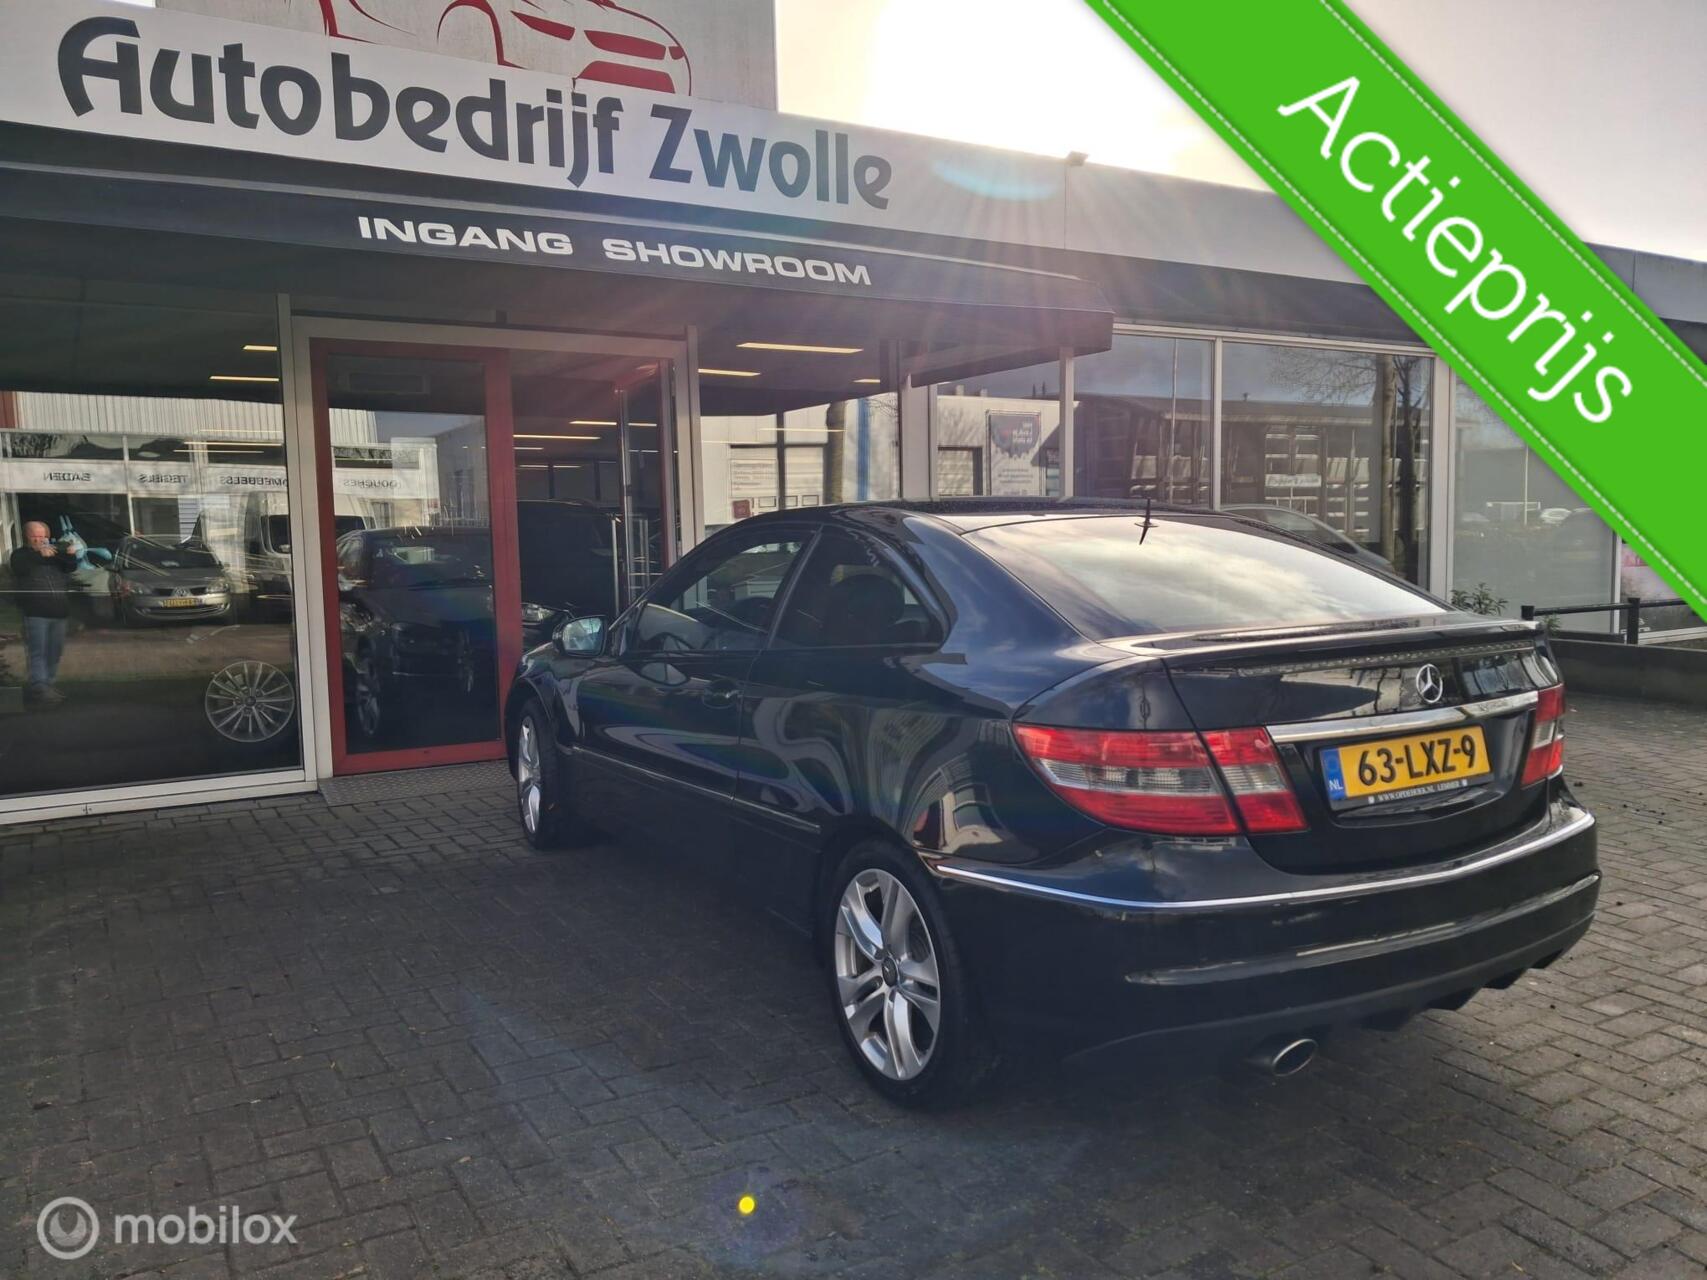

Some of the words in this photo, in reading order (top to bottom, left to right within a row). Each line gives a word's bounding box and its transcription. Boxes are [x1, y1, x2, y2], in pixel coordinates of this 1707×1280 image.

[58, 17, 622, 188] Autobedrijf
[650, 104, 892, 210] Zwolle
[358, 216, 573, 256] INGANG
[603, 239, 872, 286] SHOWROOM
[1328, 779, 1344, 790] NL
[1358, 735, 1475, 786] 63-LXZ-9
